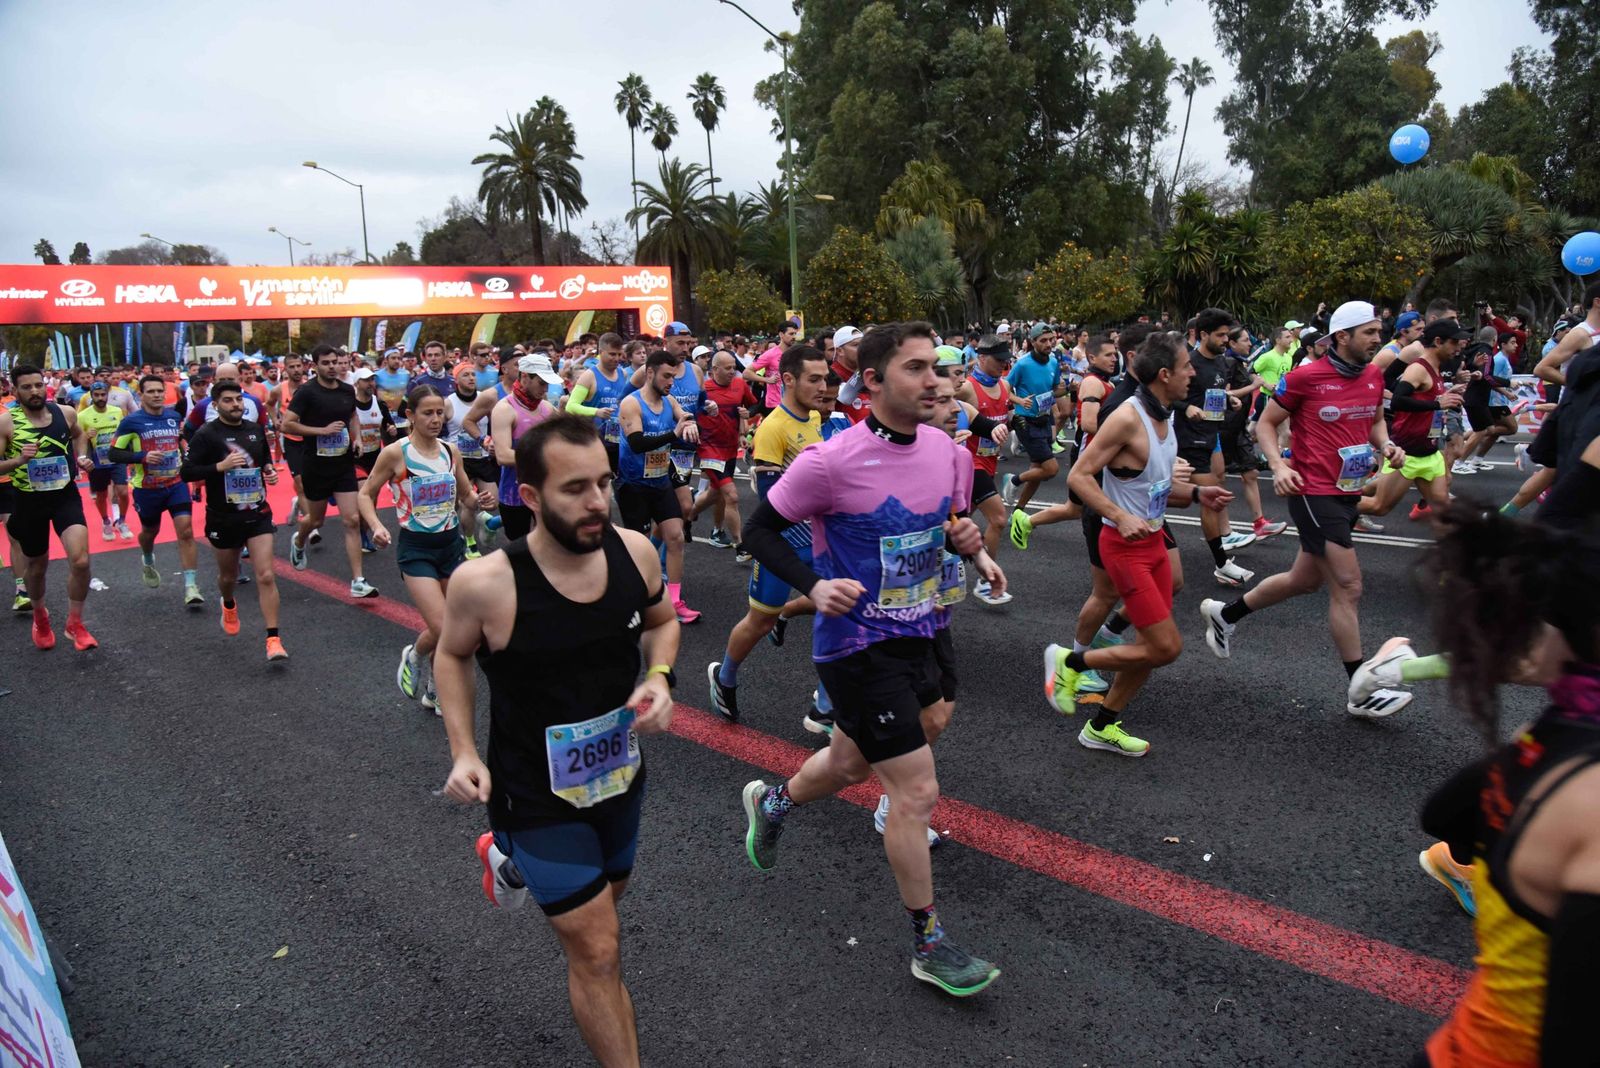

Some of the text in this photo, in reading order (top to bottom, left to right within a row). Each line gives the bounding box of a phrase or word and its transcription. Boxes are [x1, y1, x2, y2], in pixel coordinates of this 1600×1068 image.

[115, 284, 180, 303] HOKA
[428, 281, 475, 298] HOKA
[34, 464, 59, 477] 2554
[231, 477, 257, 488] 3605
[418, 483, 448, 500] 3127
[896, 548, 935, 576] 2907
[567, 732, 622, 774] 2696
